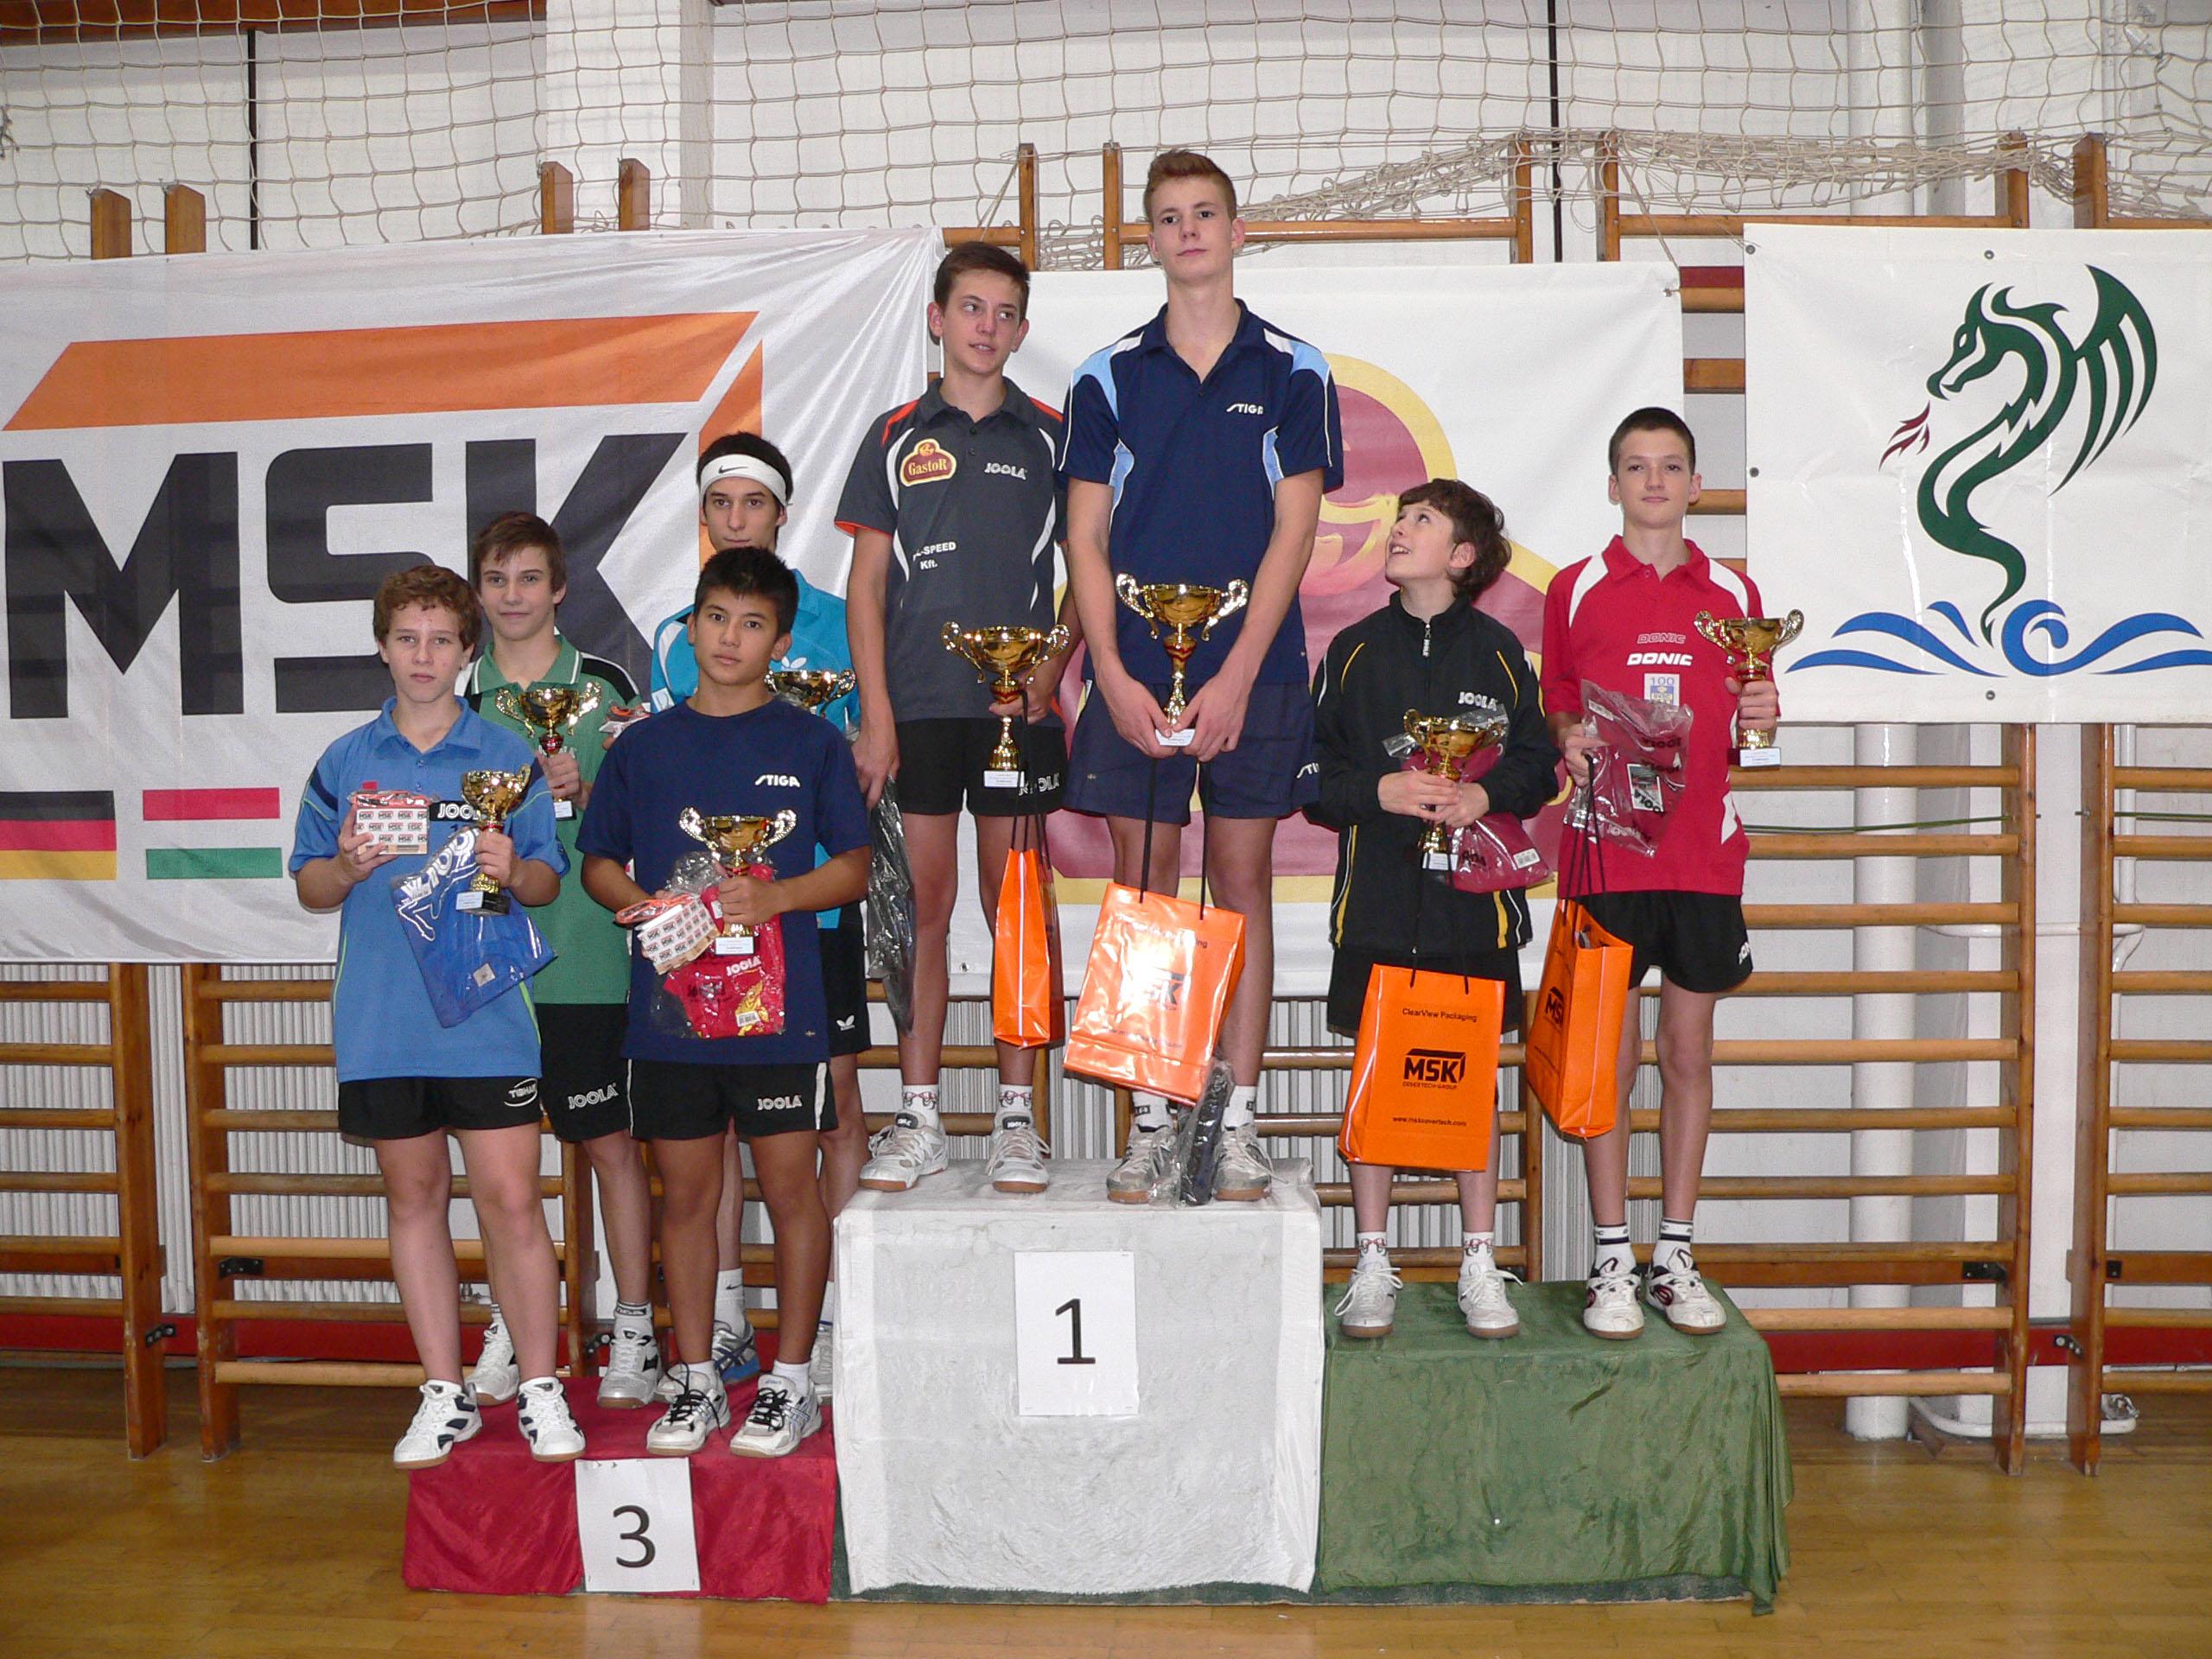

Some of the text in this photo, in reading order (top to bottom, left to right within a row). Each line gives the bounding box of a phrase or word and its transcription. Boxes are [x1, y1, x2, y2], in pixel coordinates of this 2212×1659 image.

[1226, 403, 1264, 415] STIGA
[908, 458, 948, 476] GastoR
[984, 462, 1027, 480] JOOLA
[919, 559, 938, 570] Kft.
[3, 432, 689, 719] MSK
[1637, 632, 1686, 645] DONIC
[1626, 652, 1693, 666] DONIC
[1649, 677, 1675, 686] 100
[1458, 691, 1497, 711] JOOLA
[1296, 762, 1320, 779] STI
[754, 774, 801, 787] STIGA
[437, 803, 482, 820] JOOL
[726, 956, 762, 976] JOOLA
[1402, 1007, 1478, 1023] ClearView Packaging
[1545, 991, 1565, 1026] MS
[1403, 1057, 1460, 1084] MSK
[568, 1084, 619, 1109] JOOLA
[757, 1095, 803, 1110] JOOLA
[1055, 1298, 1096, 1364] 1
[613, 1504, 656, 1568] 3
